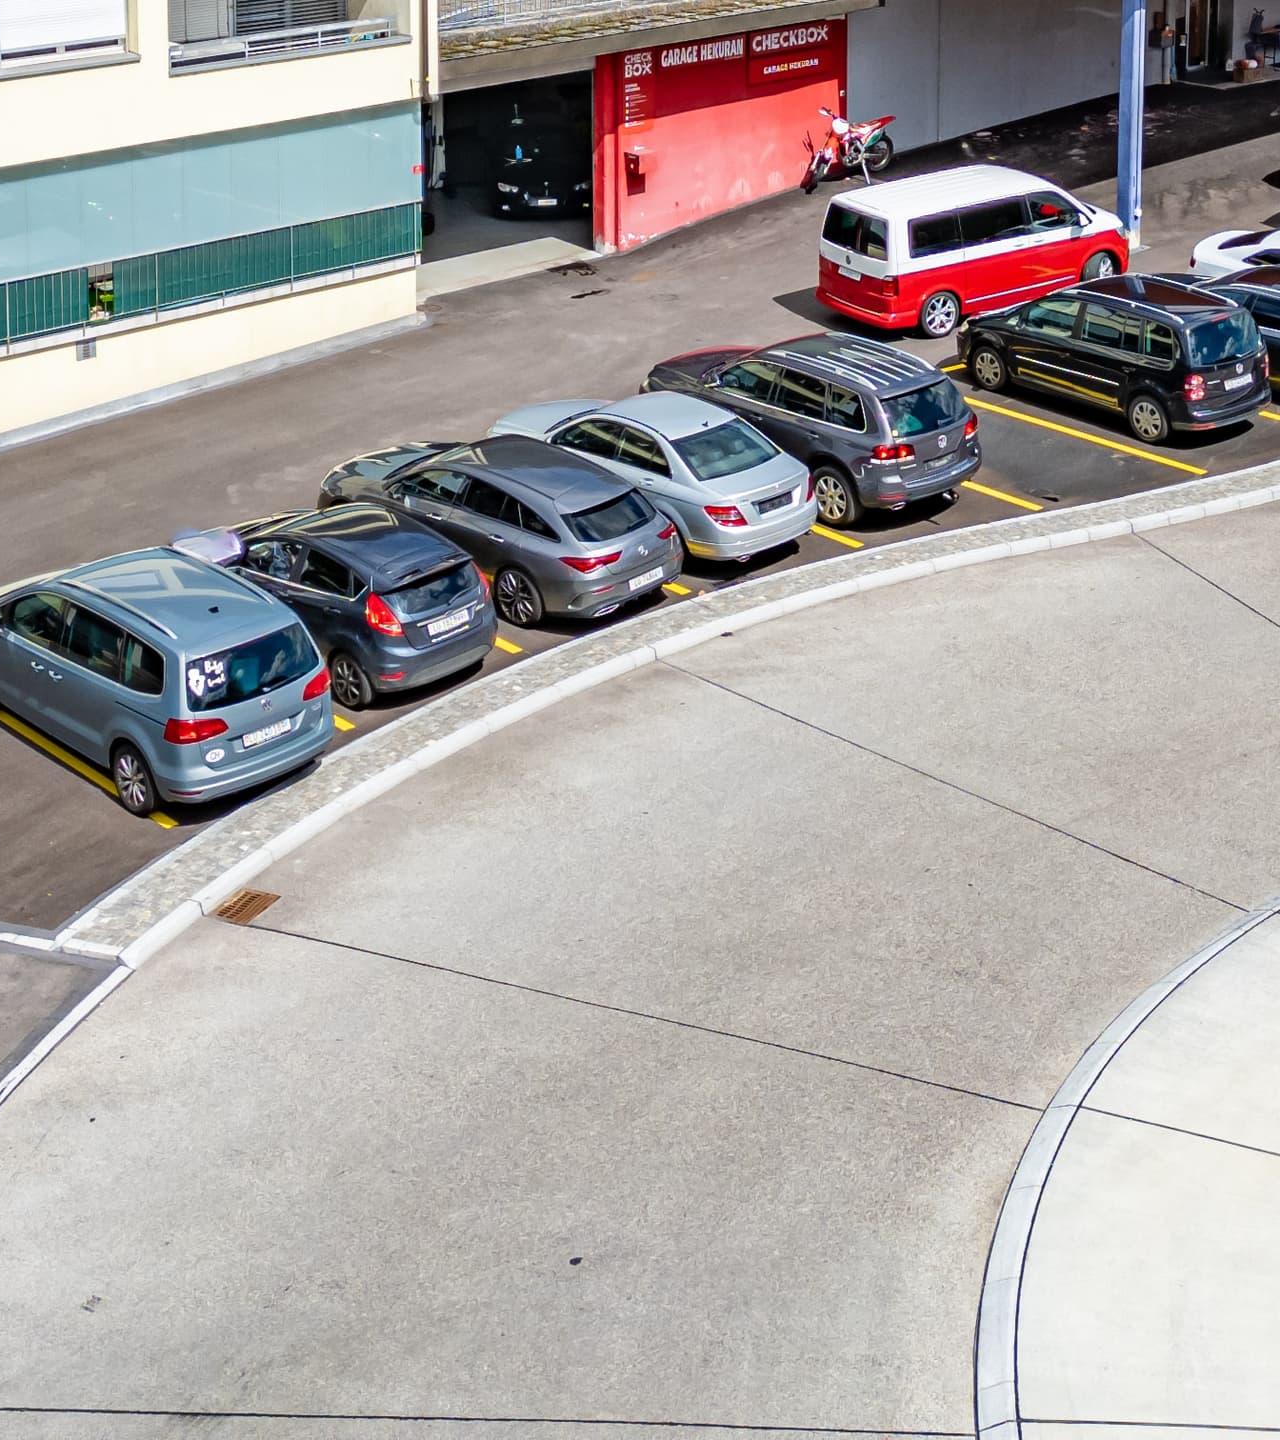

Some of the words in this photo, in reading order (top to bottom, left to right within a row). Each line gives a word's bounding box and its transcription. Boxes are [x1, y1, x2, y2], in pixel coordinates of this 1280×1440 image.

[752, 24, 829, 52] CHECKBOX
[624, 52, 652, 65] CHECK
[661, 45, 698, 68] GARAGE
[700, 38, 744, 61] HEKURAN
[624, 62, 653, 78] BOX
[209, 751, 221, 760] CH
